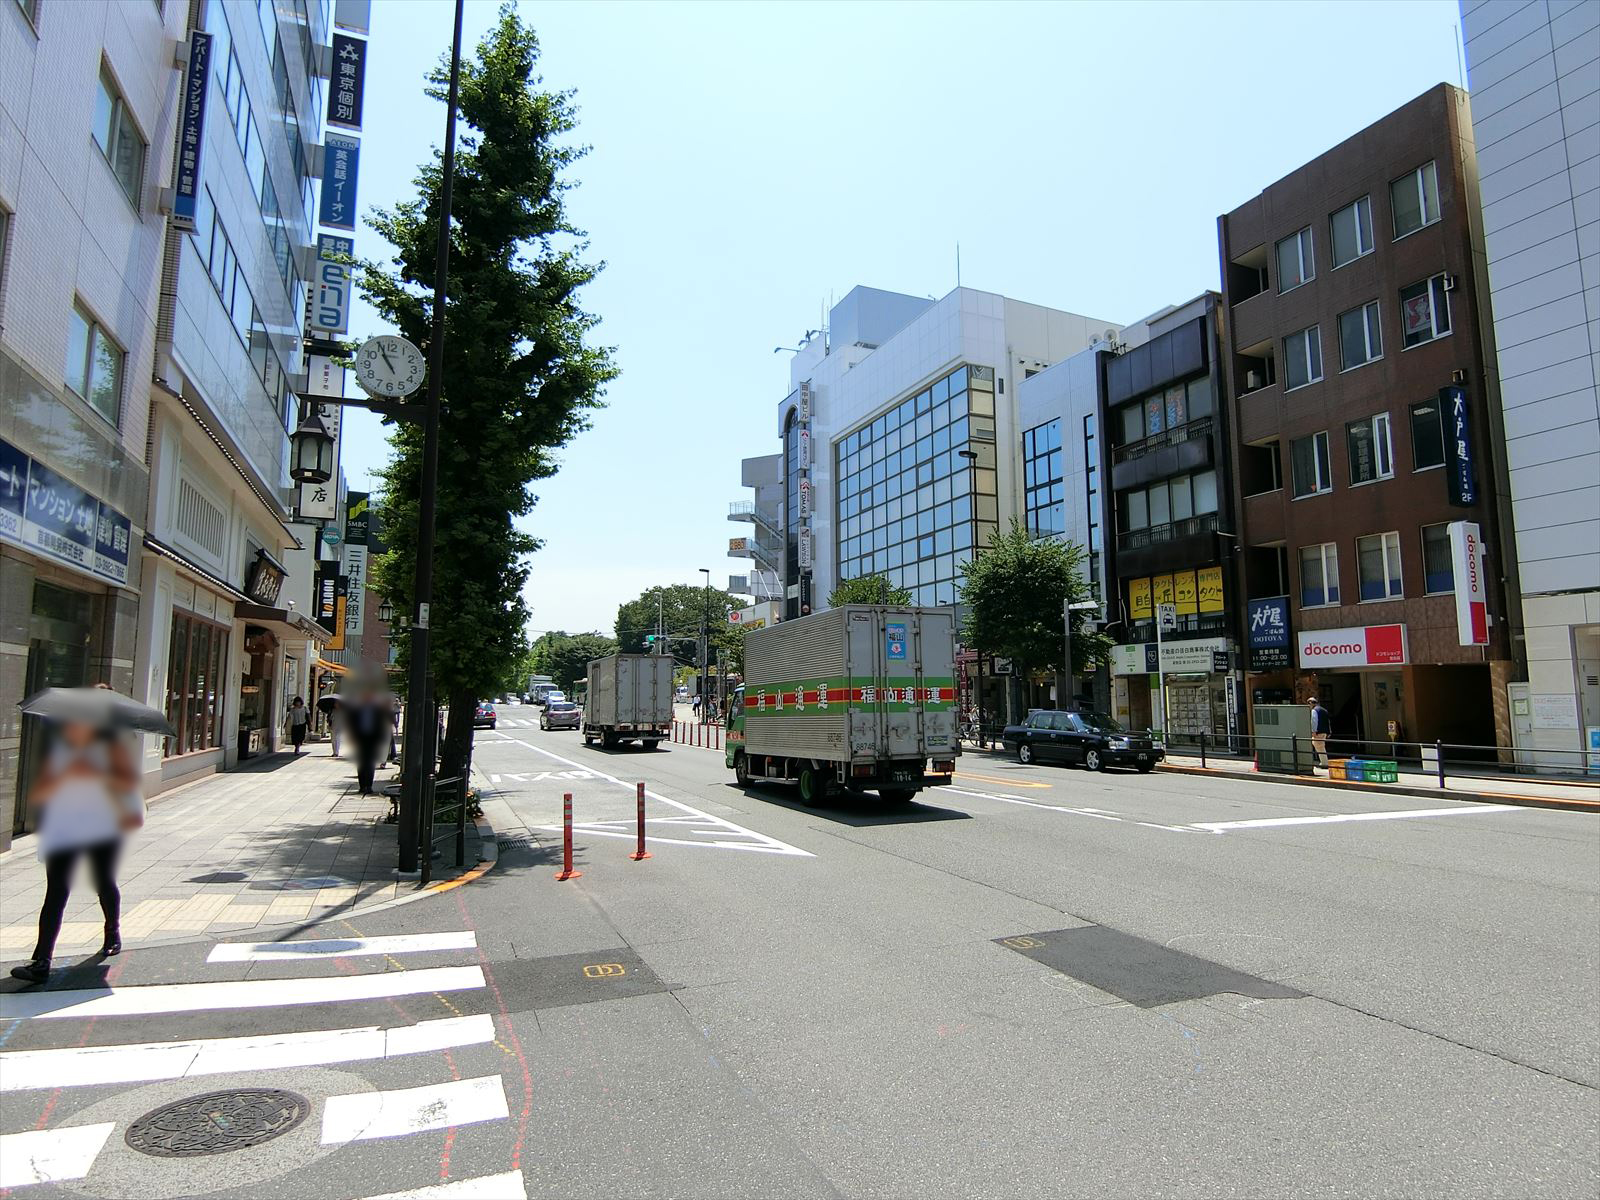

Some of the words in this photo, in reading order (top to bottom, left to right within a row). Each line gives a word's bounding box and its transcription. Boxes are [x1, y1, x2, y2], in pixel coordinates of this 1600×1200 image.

[336, 62, 356, 120] 東京個別
[332, 150, 347, 222] 英会話イーオン
[319, 264, 344, 327] ena
[387, 343, 398, 352] 12
[366, 349, 377, 360] 10
[407, 355, 415, 364] 2
[363, 359, 371, 369] 9
[410, 365, 418, 374] 3
[367, 369, 375, 379] 8
[406, 375, 413, 383] 4
[375, 378, 383, 387] 7
[385, 382, 393, 391] 6
[397, 381, 405, 390] 5
[1453, 392, 1469, 461] 大戸屋
[30, 478, 75, 524] マンション
[1461, 492, 1473, 503] 2F
[347, 520, 368, 528] SMBC
[1467, 534, 1478, 592] docomo
[345, 550, 363, 630] 三井住友銀行
[321, 579, 335, 618] DOUTOR
[1160, 605, 1175, 613] TAXI
[1251, 604, 1284, 632] 大戸屋
[1253, 635, 1283, 643] OOTOYA
[1304, 643, 1362, 656] docomo
[757, 683, 829, 712] 福山通運
[860, 685, 941, 705] 福山通運
